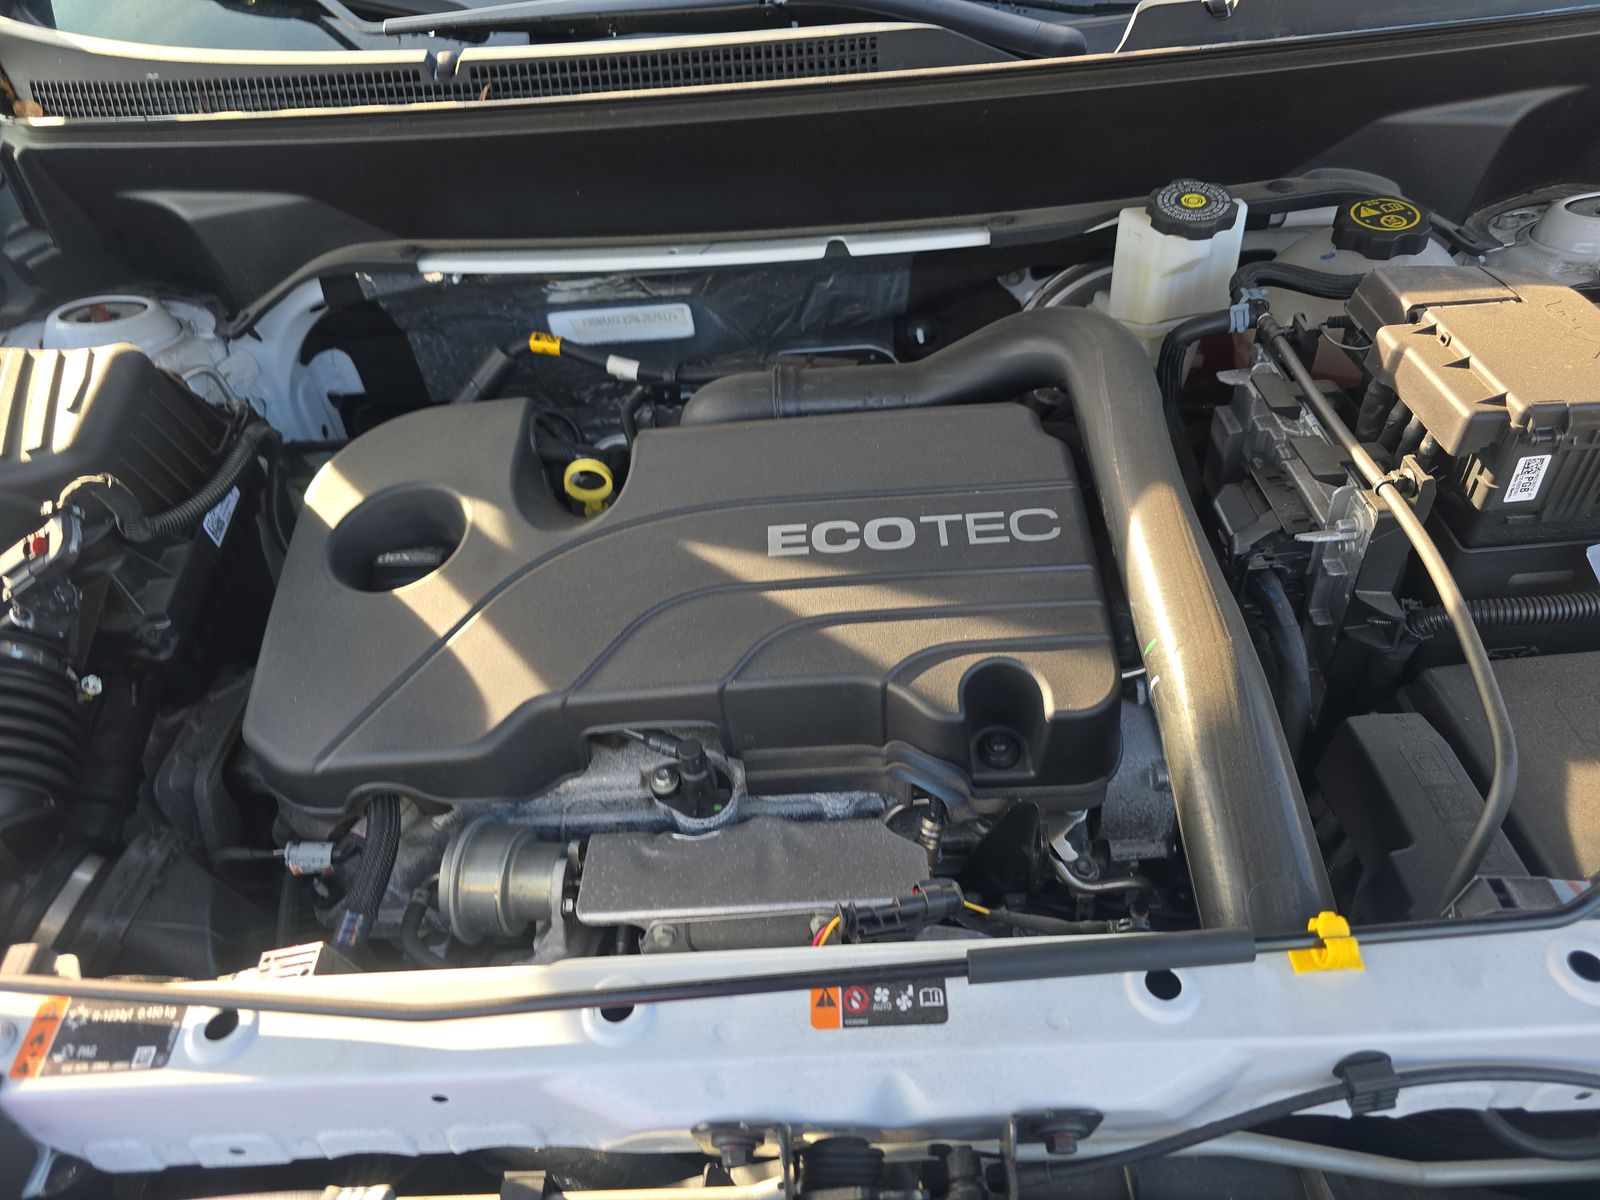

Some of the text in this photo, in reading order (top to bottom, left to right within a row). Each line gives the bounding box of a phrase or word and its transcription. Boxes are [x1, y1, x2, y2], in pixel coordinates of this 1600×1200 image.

[1520, 476, 1534, 493] PGB
[768, 508, 1061, 557] ECOTEC
[873, 1002, 892, 1011] AUTO
